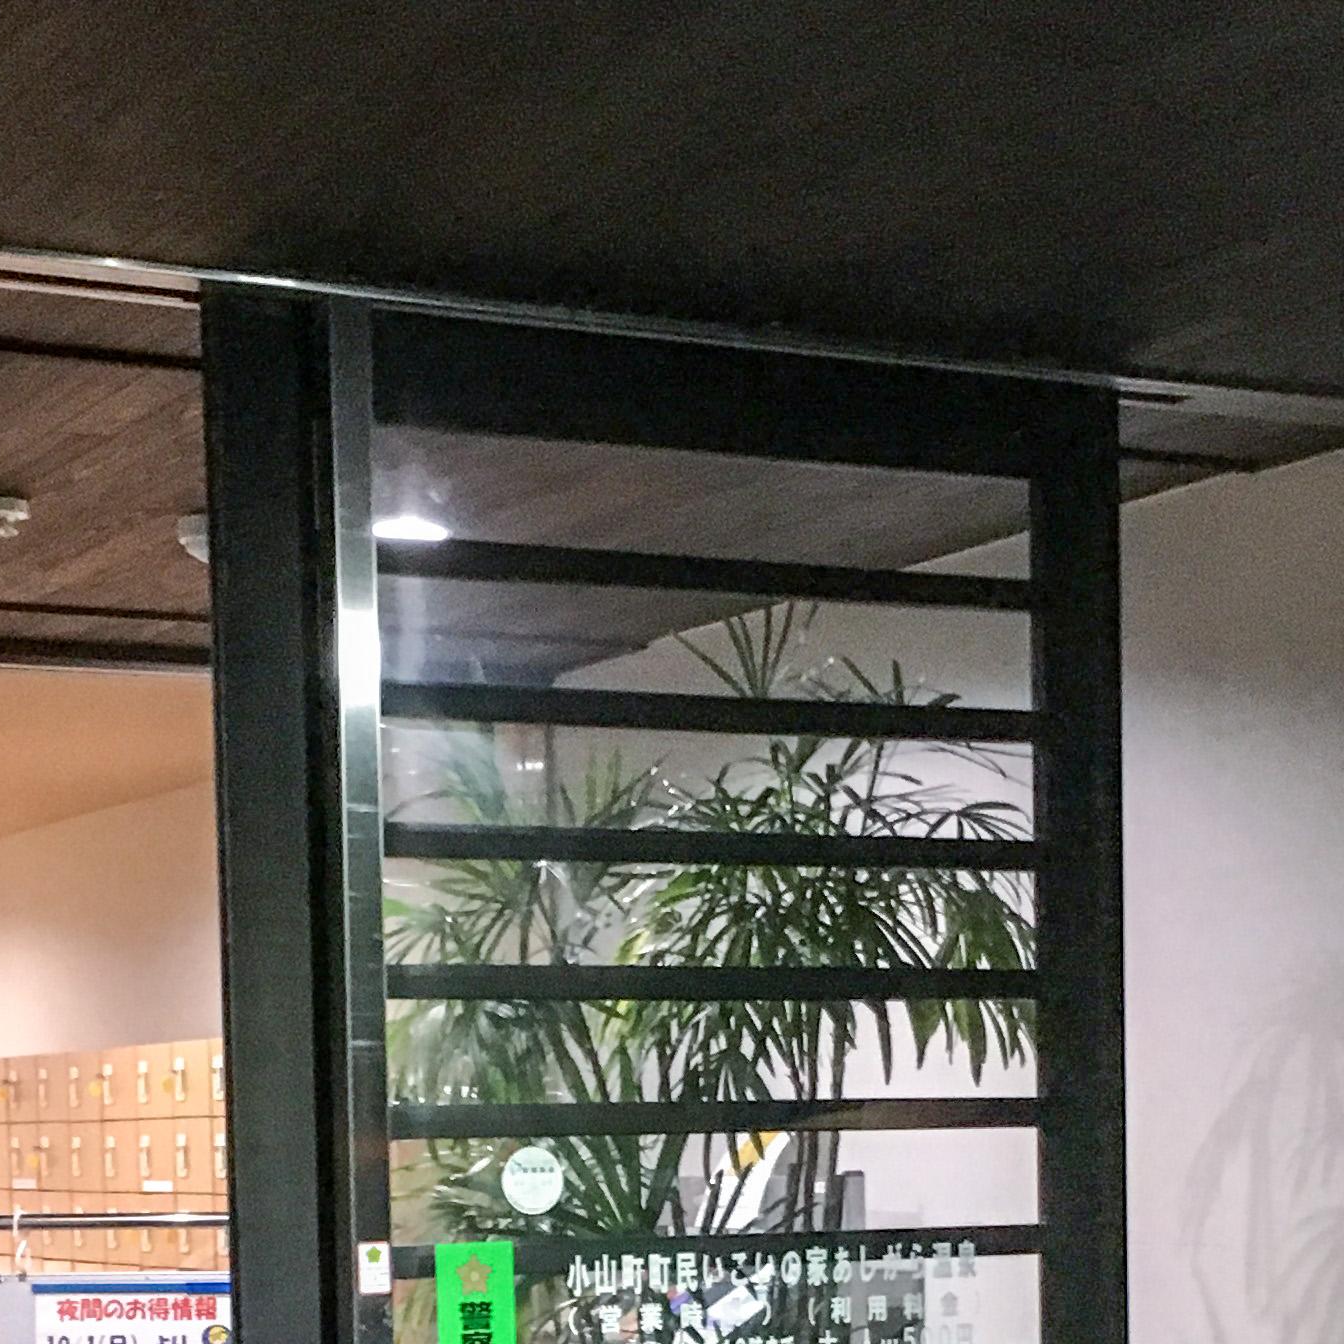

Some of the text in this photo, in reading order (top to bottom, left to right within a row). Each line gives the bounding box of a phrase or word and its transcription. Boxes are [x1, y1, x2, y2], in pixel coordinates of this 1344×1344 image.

[57, 1296, 218, 1322] 夜間のお得情報
